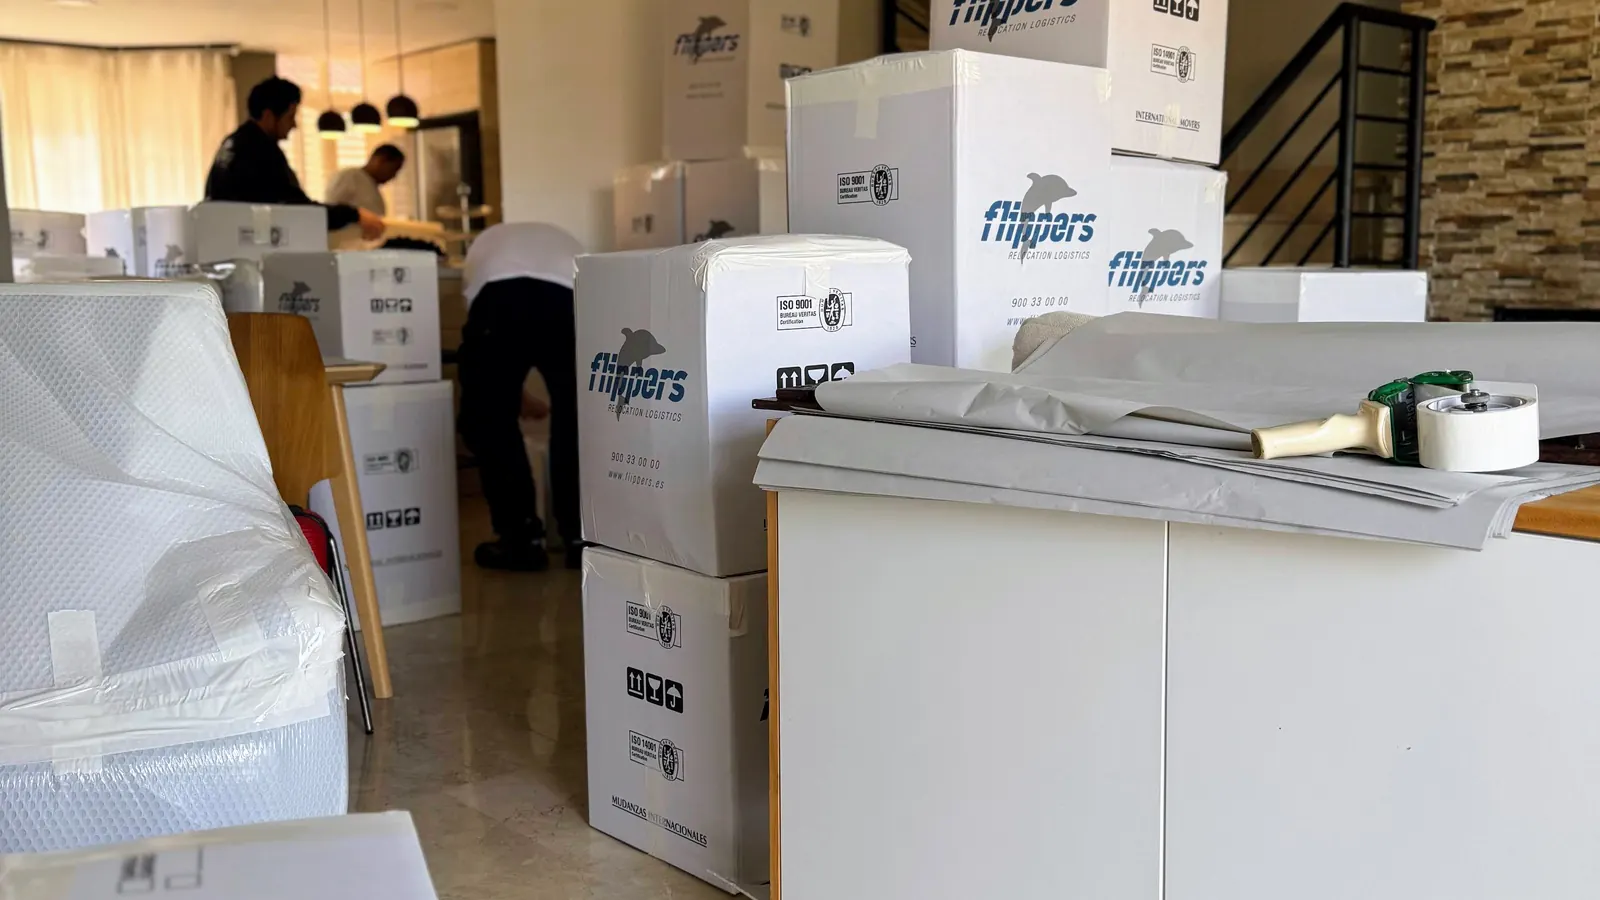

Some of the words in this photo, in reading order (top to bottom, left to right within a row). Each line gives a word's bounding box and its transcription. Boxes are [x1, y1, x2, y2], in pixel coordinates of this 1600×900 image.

[978, 21, 1027, 37] RECATION
[1030, 14, 1076, 29] LOGISTICS
[1154, 48, 1162, 57] ISO
[1163, 50, 1176, 60] 14001
[1180, 118, 1200, 129] MOVERS
[840, 177, 850, 186] ISO
[851, 175, 864, 185] 9001
[981, 200, 1097, 250] flippers
[1054, 251, 1090, 260] LOGISTICS
[1108, 250, 1208, 293] flippers
[1012, 297, 1028, 307] 900
[1031, 297, 1042, 307] 33
[1045, 297, 1055, 306] 00
[1058, 296, 1068, 306] 00
[1170, 292, 1200, 302] LOGISTICS
[780, 300, 793, 310] ISO
[796, 299, 812, 310] 9001
[799, 310, 817, 318] VERITAS
[589, 352, 688, 405] flippers
[645, 409, 682, 422] LOGISTICS
[611, 452, 624, 463] 900
[626, 454, 636, 465] 33
[638, 456, 647, 467] 00
[650, 459, 660, 470] 00
[608, 470, 664, 489] www.flippers.es
[629, 605, 638, 617] ISO
[632, 735, 641, 746] ISO
[642, 739, 657, 753] 14001
[612, 795, 647, 818] MUDANZAS
[648, 811, 707, 845] INTERNACIONALES
